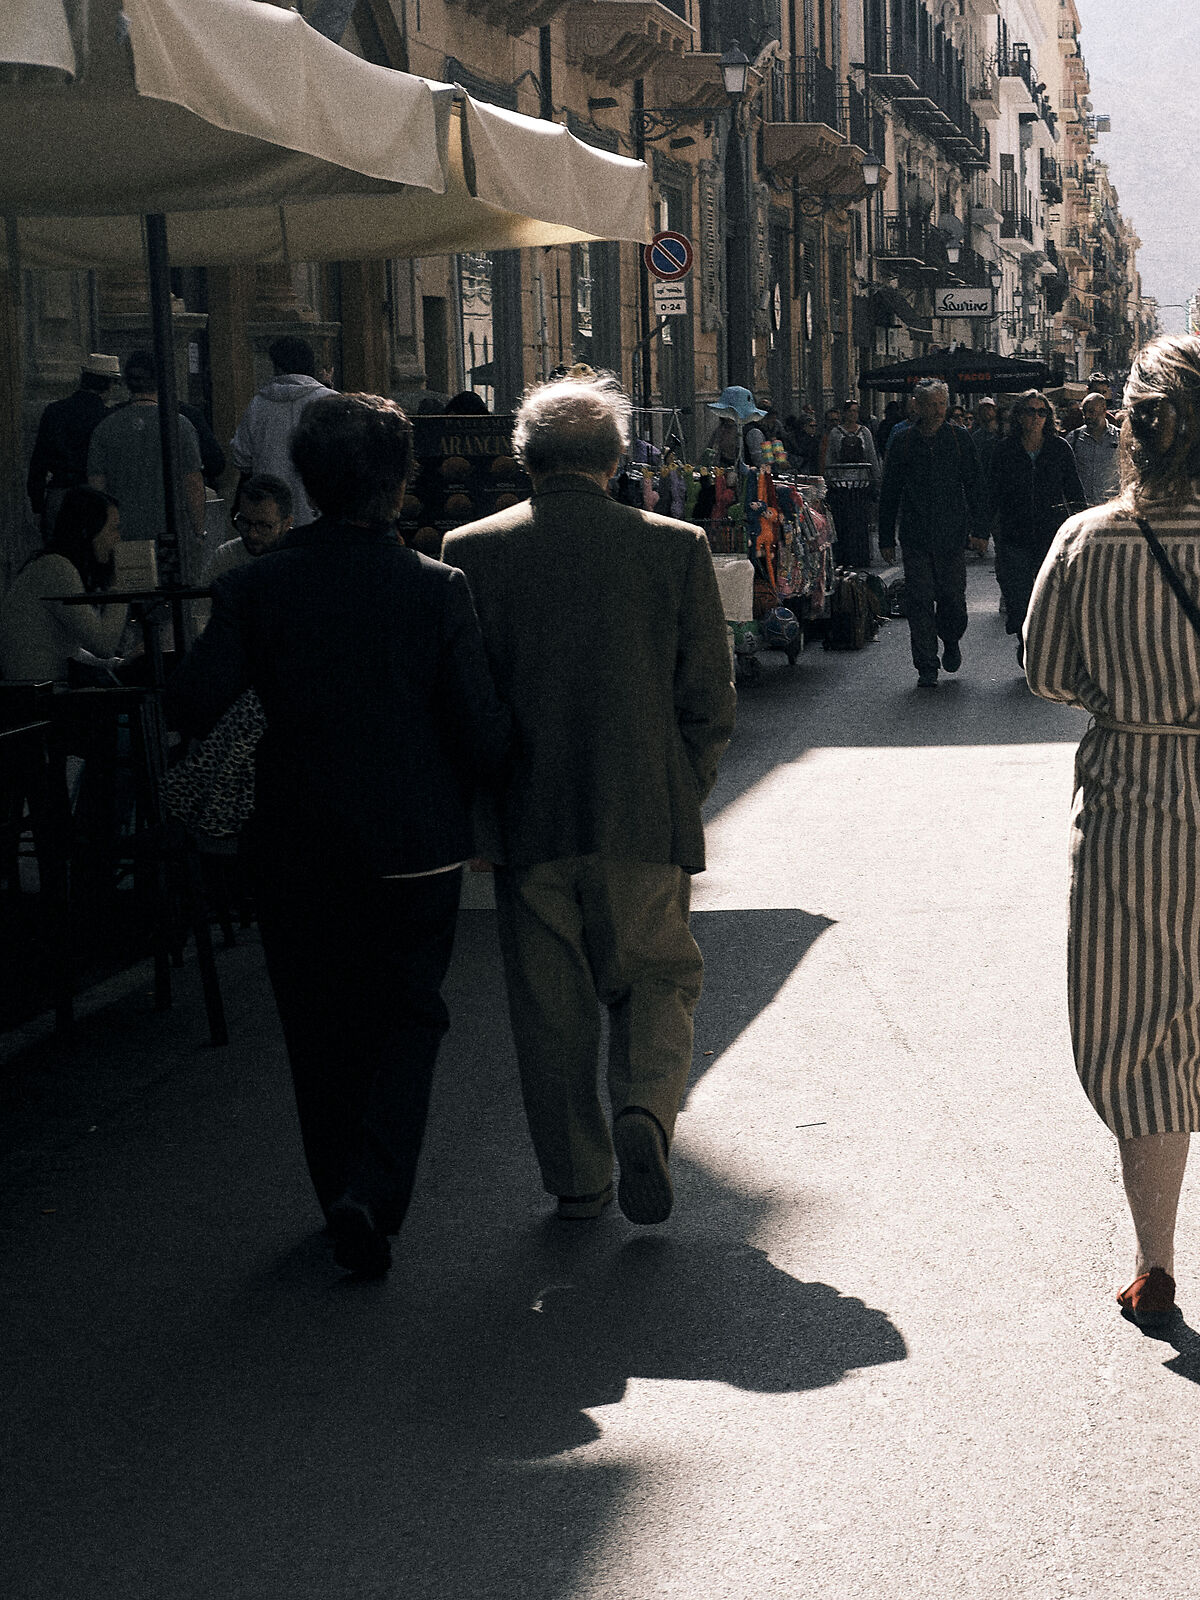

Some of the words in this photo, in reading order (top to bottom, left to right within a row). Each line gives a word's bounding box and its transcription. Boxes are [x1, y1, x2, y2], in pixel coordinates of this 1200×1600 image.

[660, 303, 681, 311] 0-24
[938, 293, 988, 312] Laurino
[957, 372, 991, 382] TACOS
